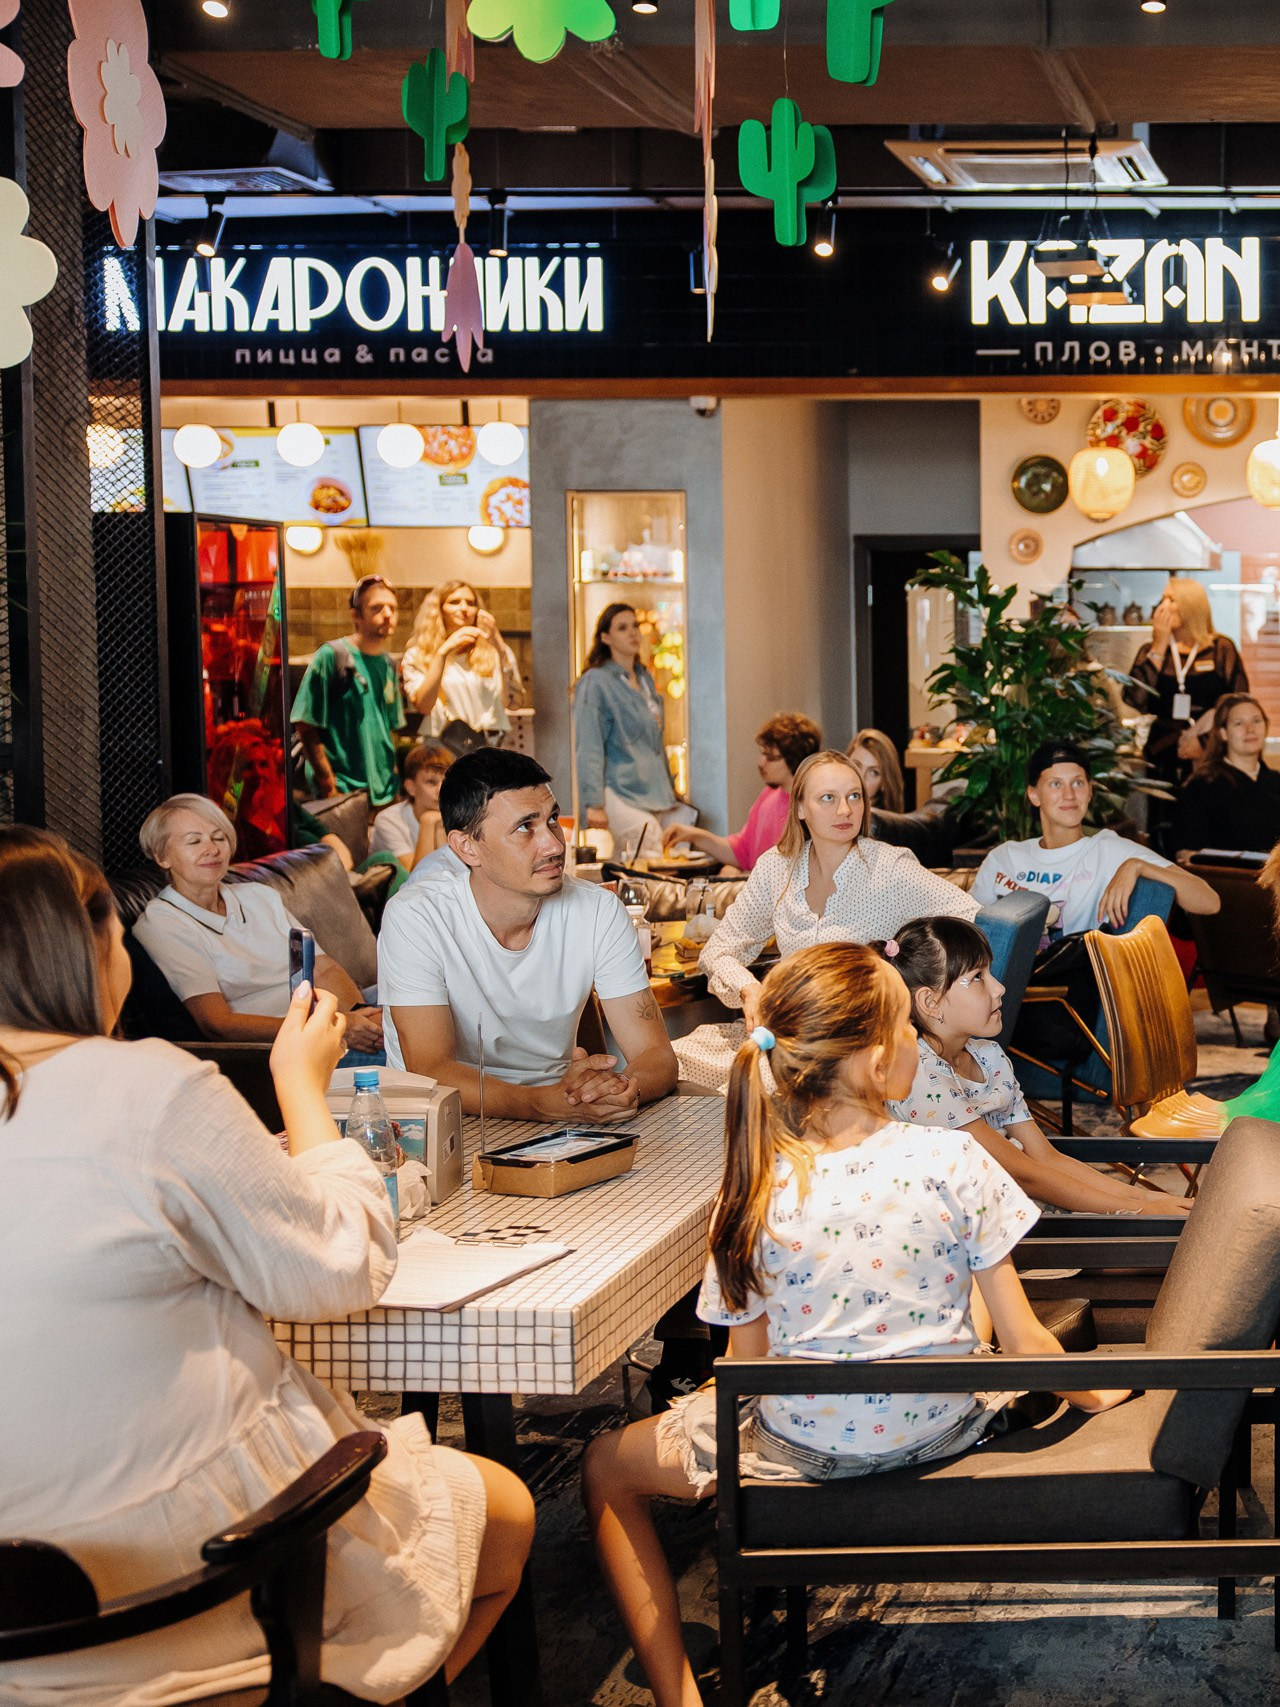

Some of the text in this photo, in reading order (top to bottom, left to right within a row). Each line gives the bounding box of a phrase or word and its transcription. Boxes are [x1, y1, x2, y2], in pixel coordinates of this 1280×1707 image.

[103, 256, 604, 332] МАКАРОНИКИ
[970, 237, 1260, 325] KAZAN
[235, 343, 494, 365] пицца & паса
[1034, 340, 1137, 362] ПЛОВ
